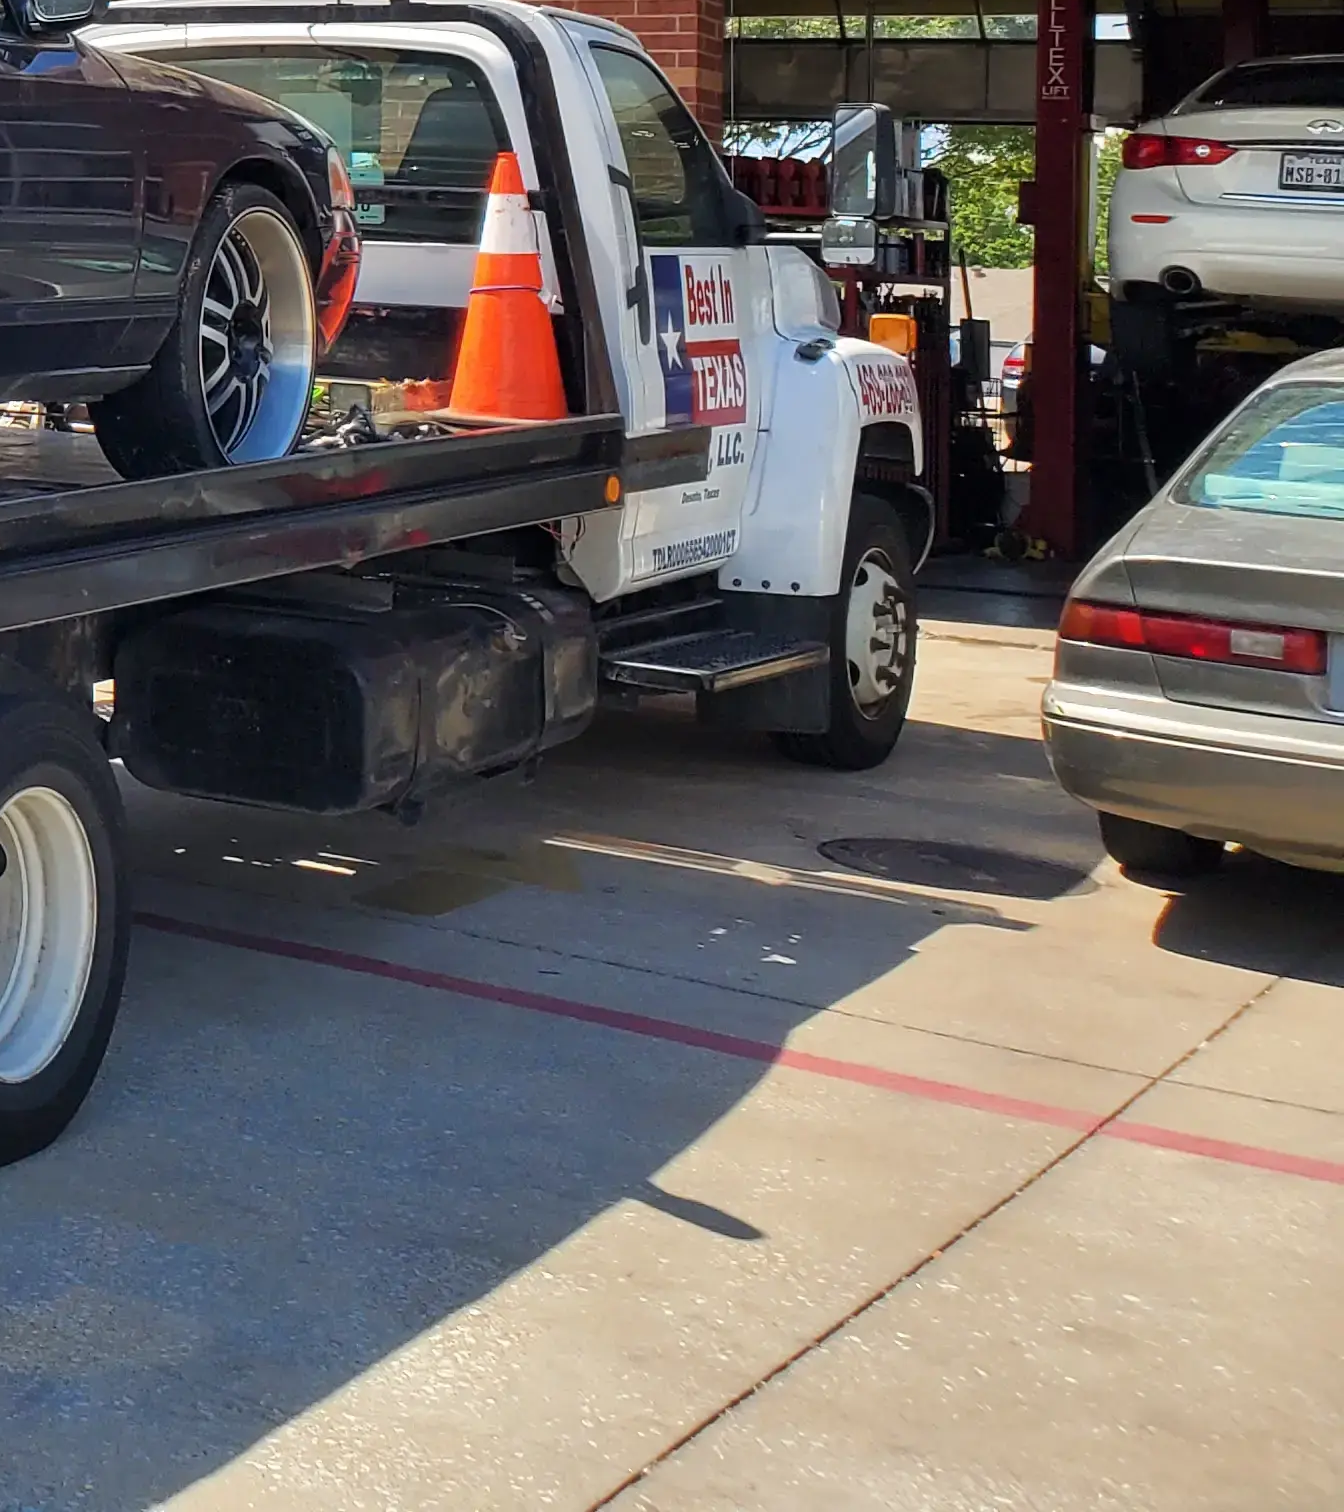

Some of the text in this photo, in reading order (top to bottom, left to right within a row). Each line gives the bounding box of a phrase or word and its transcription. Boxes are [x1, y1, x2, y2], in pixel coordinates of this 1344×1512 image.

[1042, 86, 1069, 96] LIFT
[684, 264, 735, 326] Best In
[692, 353, 745, 411] TEXAS
[717, 432, 744, 466] LLC.
